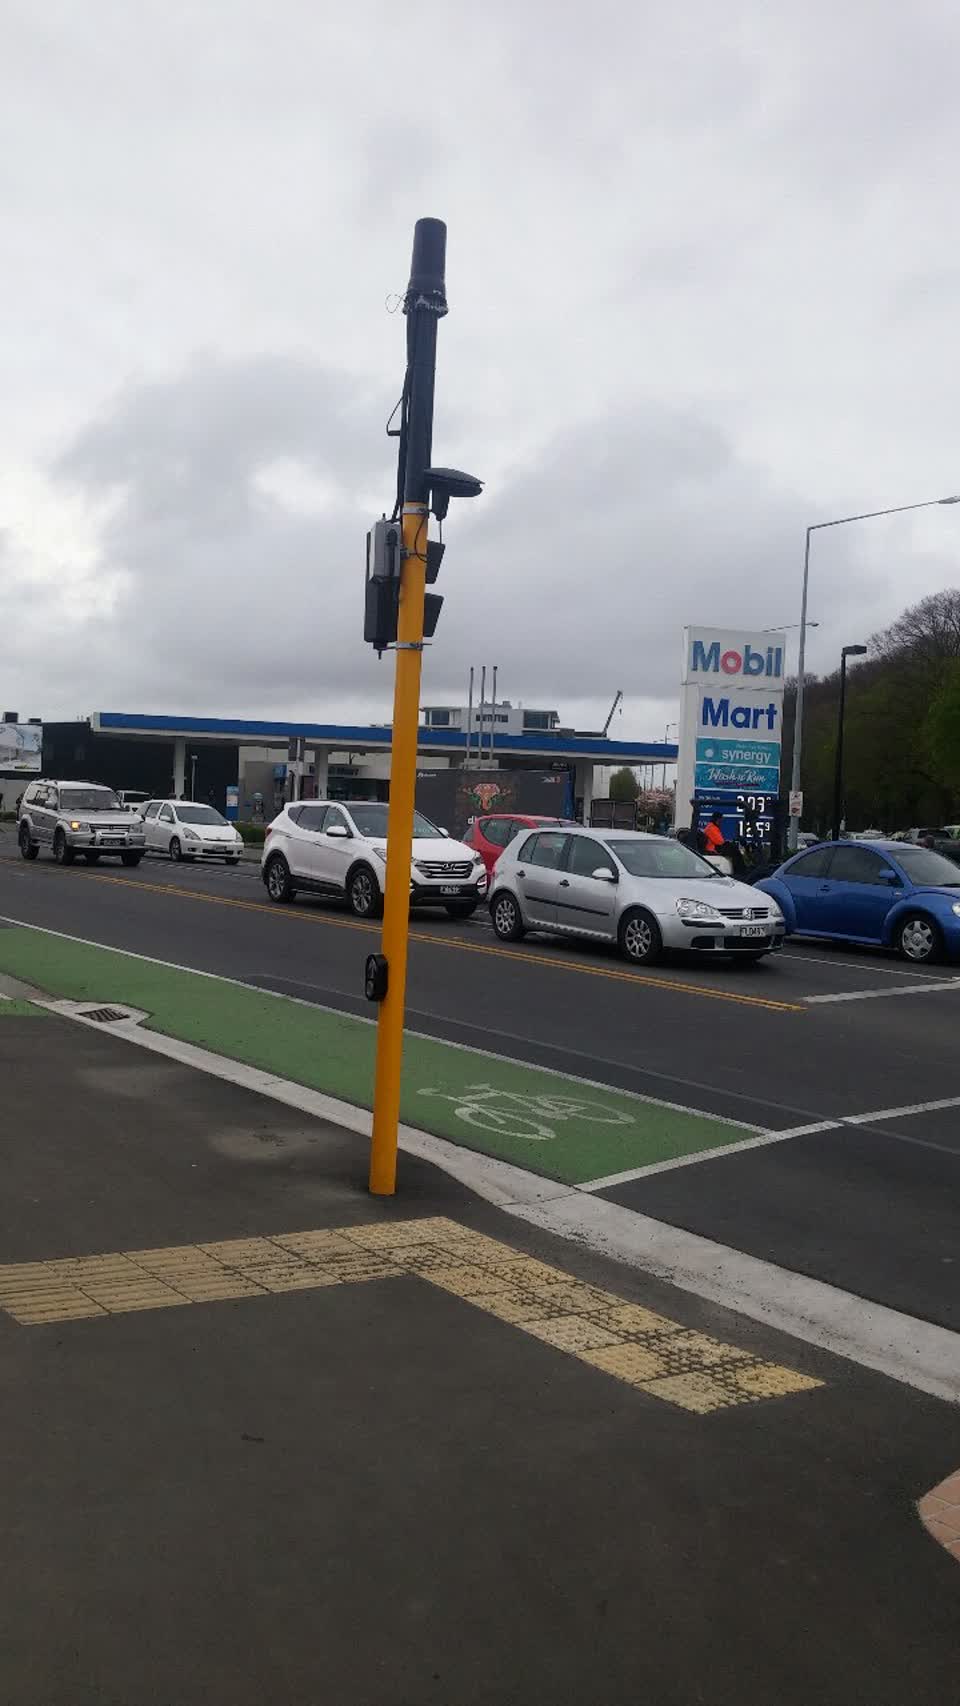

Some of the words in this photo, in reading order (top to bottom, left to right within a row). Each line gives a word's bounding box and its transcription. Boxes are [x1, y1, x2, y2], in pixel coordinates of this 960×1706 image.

[691, 640, 782, 678] Mobil
[702, 697, 777, 730] Mart
[721, 749, 771, 764] synergy
